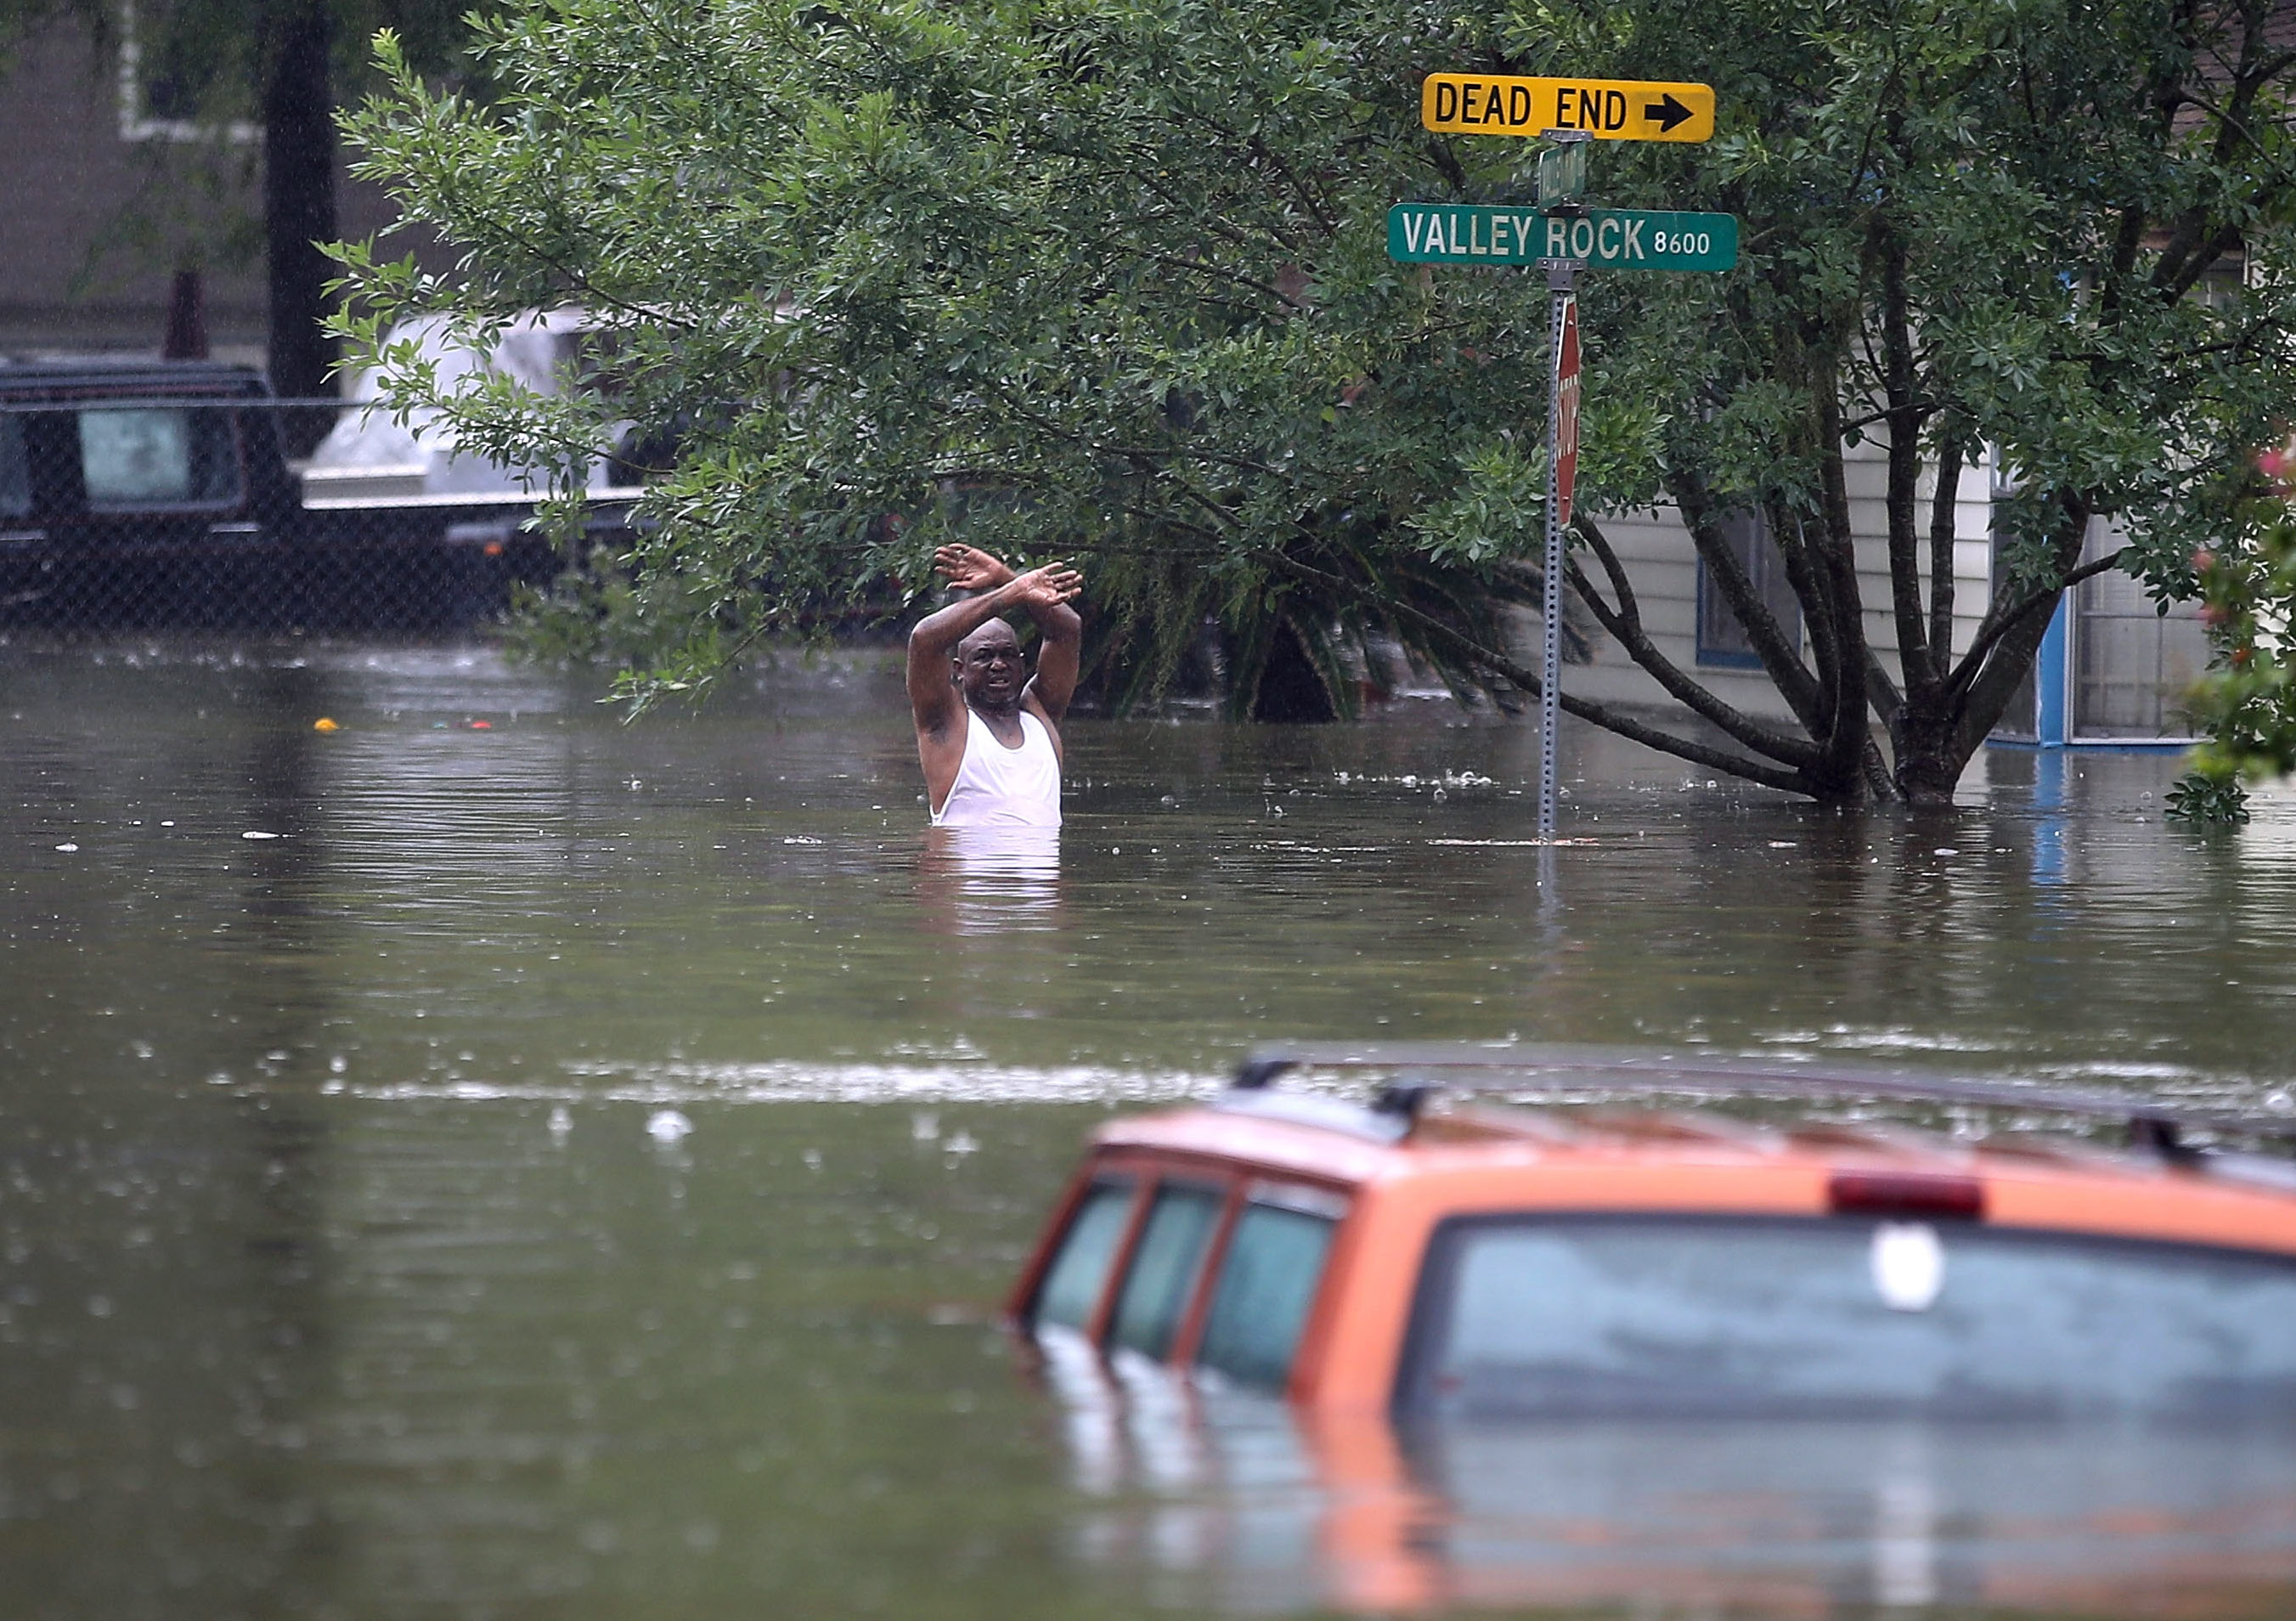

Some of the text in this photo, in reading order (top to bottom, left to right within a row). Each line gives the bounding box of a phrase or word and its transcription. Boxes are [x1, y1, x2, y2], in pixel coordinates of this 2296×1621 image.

[1435, 82, 1627, 131] DEAD END
[1402, 212, 1710, 260] VALLEY ROCK 8600
